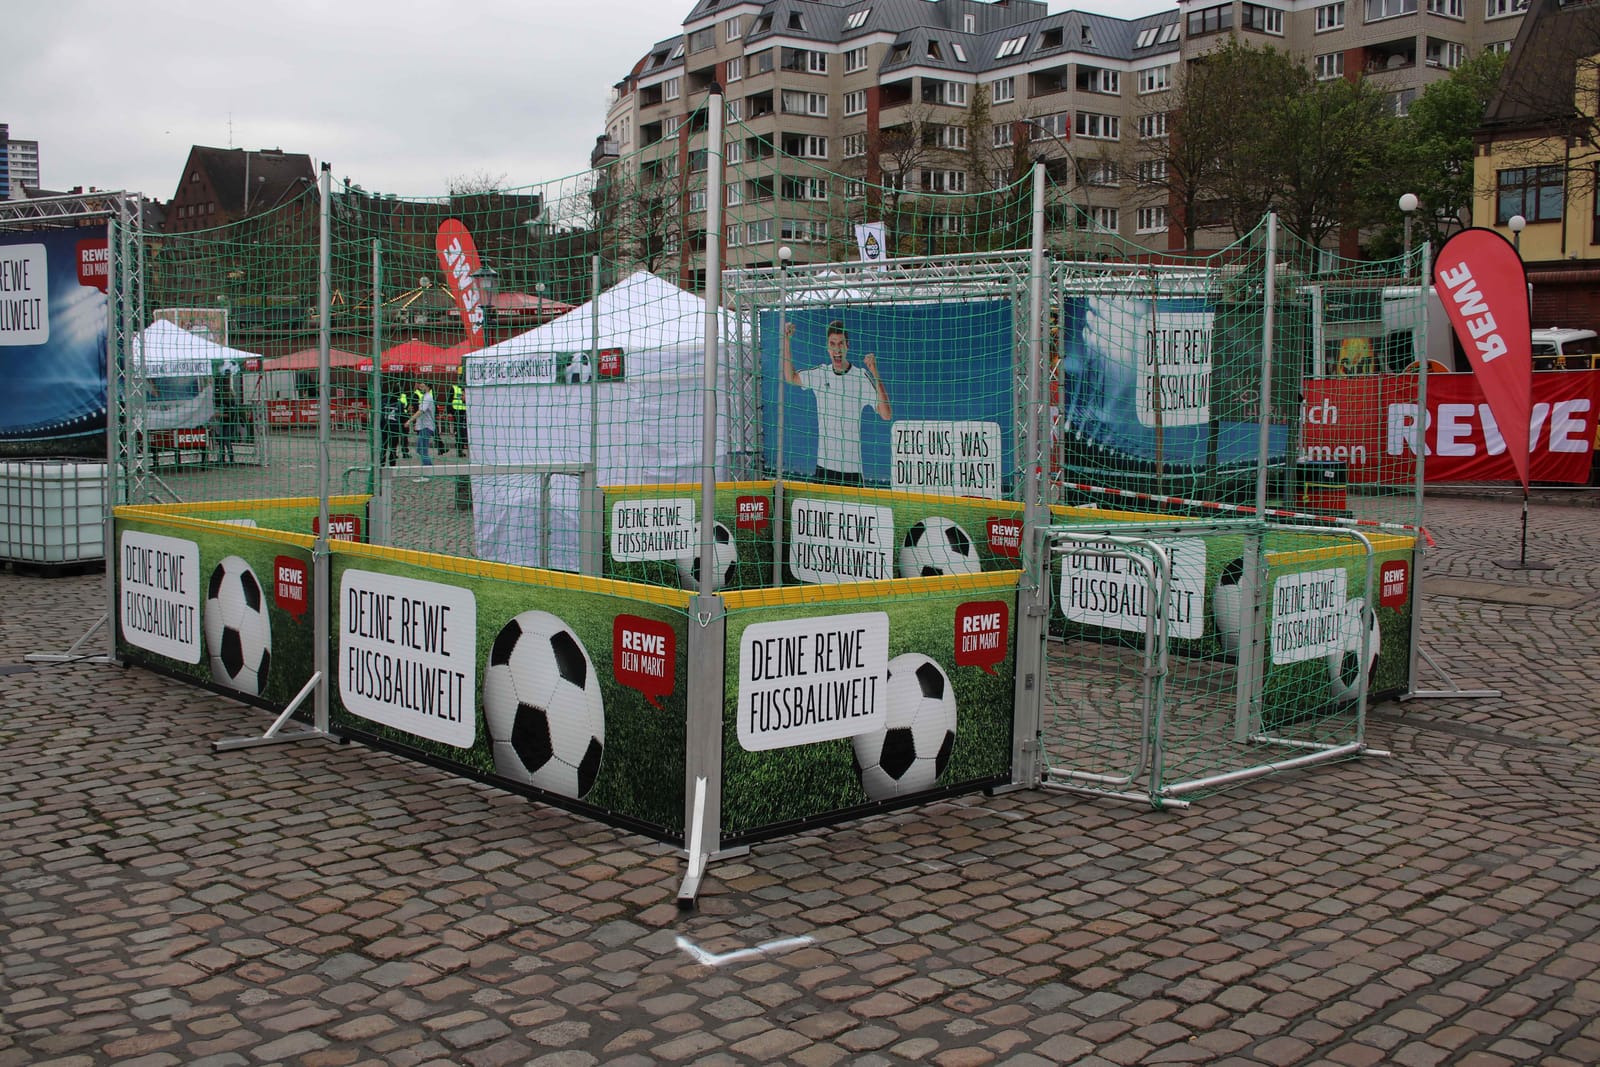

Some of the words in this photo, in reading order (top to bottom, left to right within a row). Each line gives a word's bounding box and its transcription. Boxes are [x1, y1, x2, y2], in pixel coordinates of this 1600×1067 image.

[82, 248, 108, 262] REWE
[1184, 330, 1213, 364] REW
[178, 434, 206, 442] REWE
[1388, 398, 1591, 456] REWE
[897, 430, 923, 454] ZEIG
[960, 432, 988, 457] WAS
[898, 460, 912, 484] DU
[918, 460, 953, 486] DRAUF
[960, 462, 995, 489] HAST!
[618, 507, 648, 529] DEINE
[653, 506, 682, 527] REWE
[740, 502, 764, 512] REWE
[328, 522, 353, 534] EWE
[798, 509, 834, 539] DEINE
[839, 513, 876, 544] REWE
[992, 524, 1020, 537] REWE
[618, 530, 689, 553] FUSSBALLWELT
[126, 545, 153, 587] DEINE
[157, 550, 185, 594] REWE
[798, 542, 886, 580] FUSSBALLWELT
[279, 567, 302, 584] REWE
[1384, 569, 1404, 583] REWE
[1072, 577, 1194, 623] FUSSBALLELT
[1278, 584, 1306, 615] DEINE
[1310, 580, 1334, 610] REWE
[126, 591, 194, 644] FUSSBALLWELT
[349, 588, 394, 644] DEINE
[401, 597, 451, 656] REWE
[963, 613, 1000, 633] REWE
[622, 629, 666, 656] REWE
[962, 634, 978, 653] DEIN
[979, 631, 1000, 651] MARKT
[1276, 613, 1340, 652] FUSSBALLWELT
[622, 654, 639, 673] DEIN
[641, 656, 665, 677] MARKT
[752, 635, 808, 682] DEINE
[814, 629, 866, 673] REWE
[348, 647, 464, 723] FUSSBALLWELT
[750, 676, 878, 734] FUSSBALLWELT
